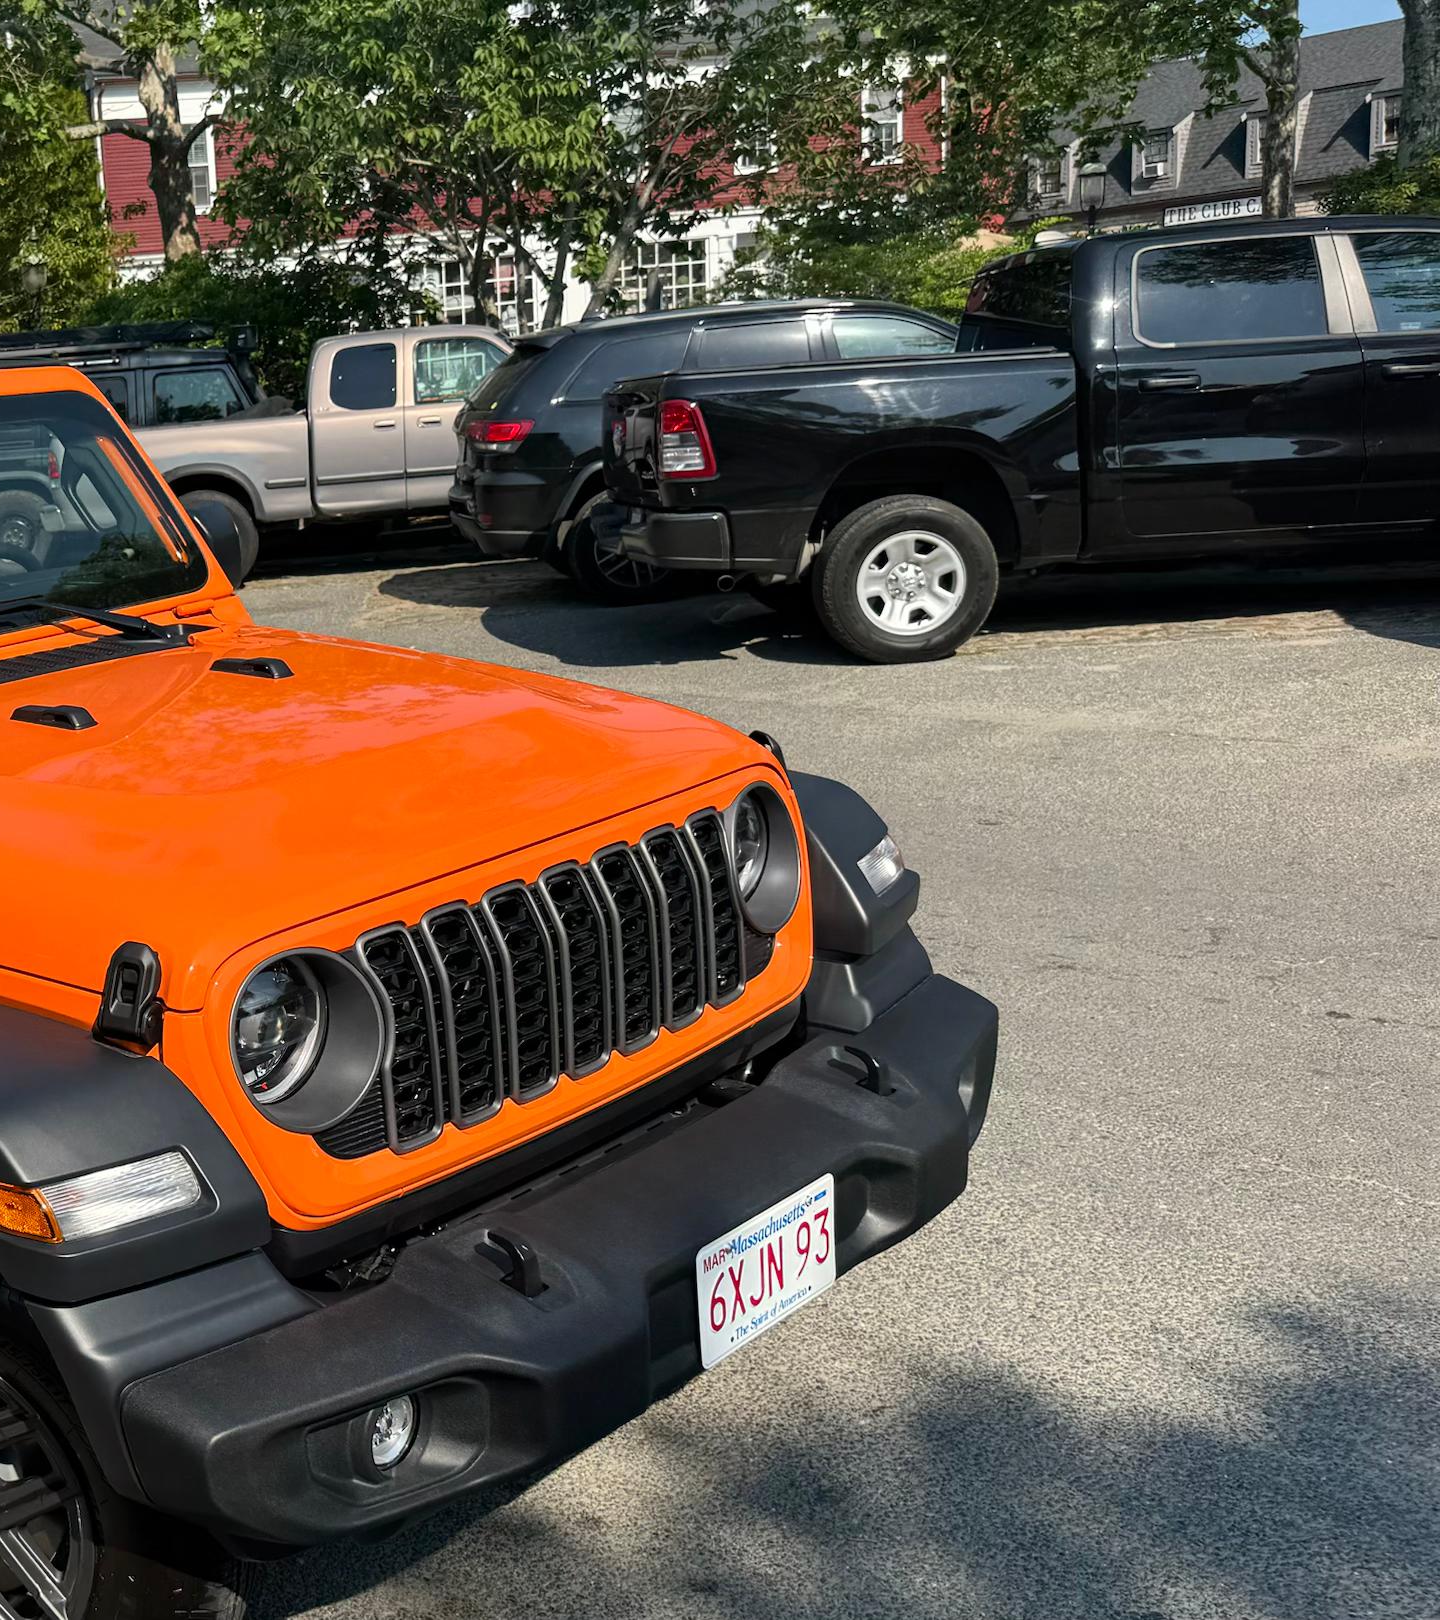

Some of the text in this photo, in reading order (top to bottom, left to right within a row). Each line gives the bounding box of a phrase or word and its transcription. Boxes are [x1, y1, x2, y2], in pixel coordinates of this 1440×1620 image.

[1166, 206, 1197, 224] THE
[1201, 200, 1241, 218] CLUB
[703, 1202, 806, 1274] MAR Massachusetts
[709, 1207, 830, 1333] 6XJN 93
[735, 1287, 808, 1340] The Spirit of America
